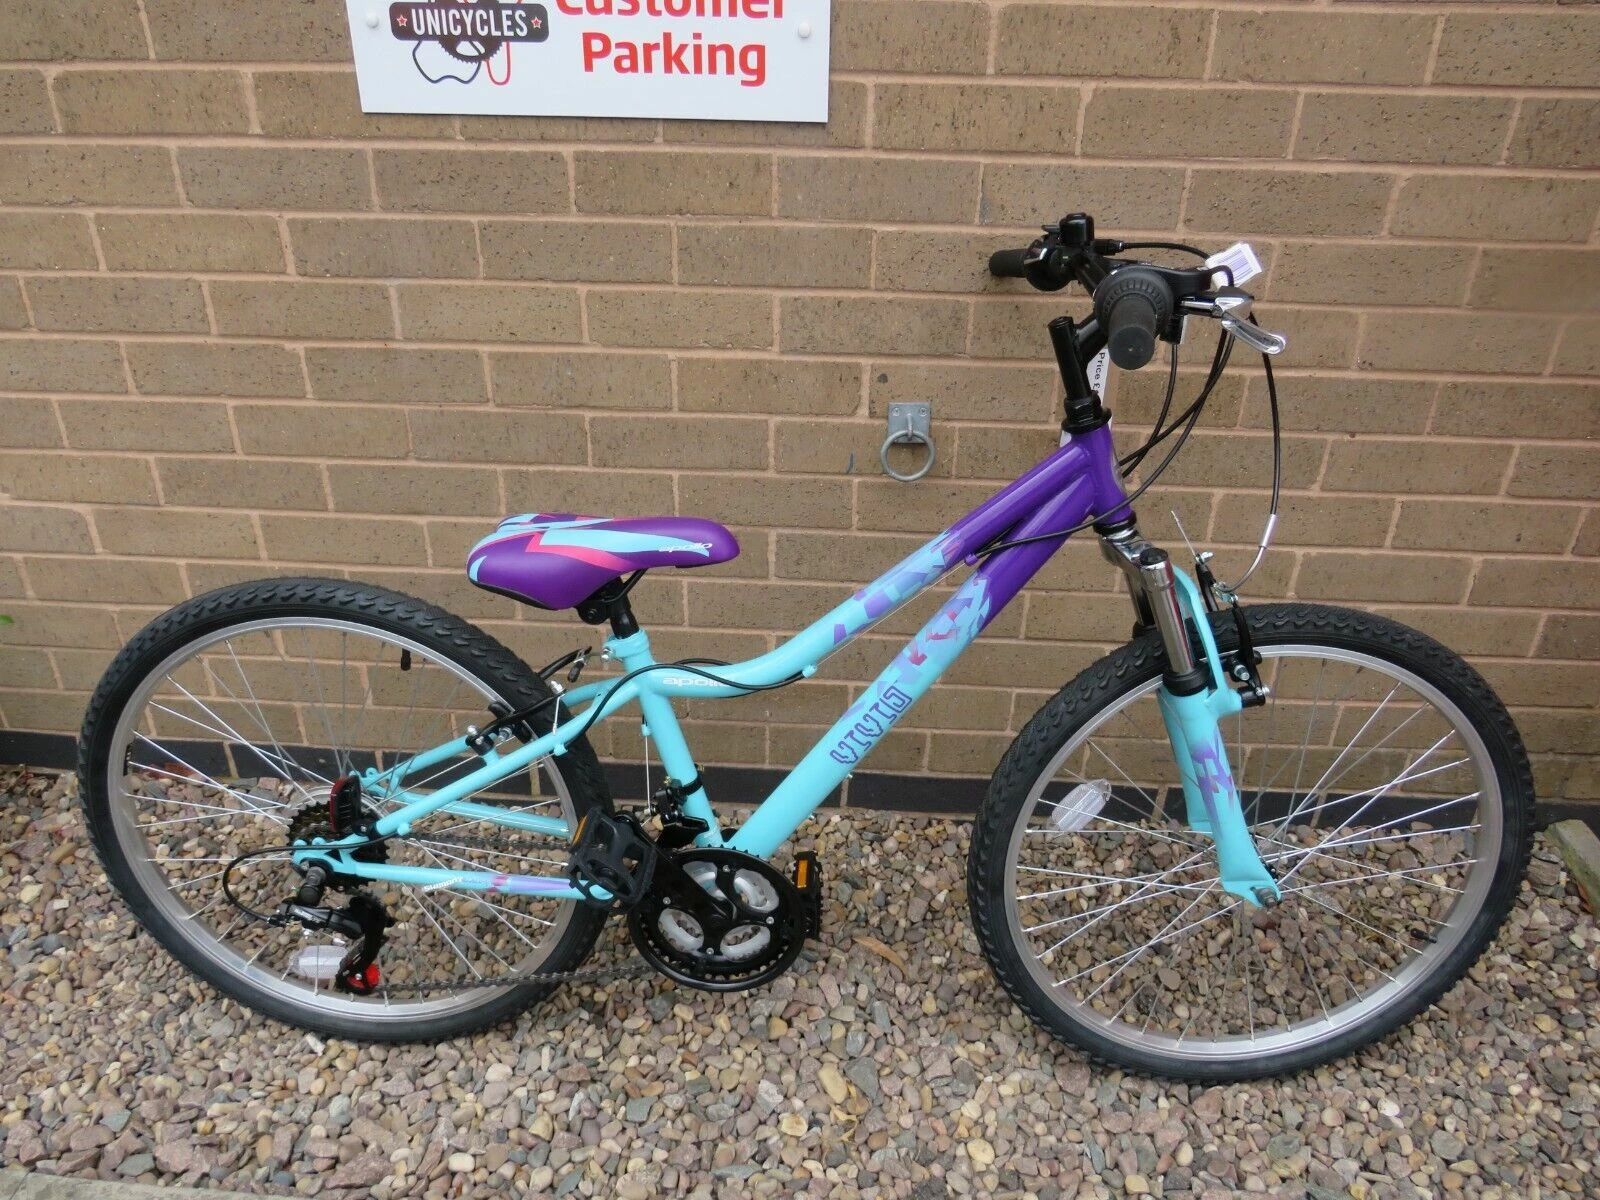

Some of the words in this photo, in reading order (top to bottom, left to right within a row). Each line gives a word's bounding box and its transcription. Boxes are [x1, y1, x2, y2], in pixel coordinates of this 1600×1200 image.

[411, 8, 528, 37] UNICYCLES
[582, 32, 767, 87] Parking
[1094, 352, 1106, 380] Price
